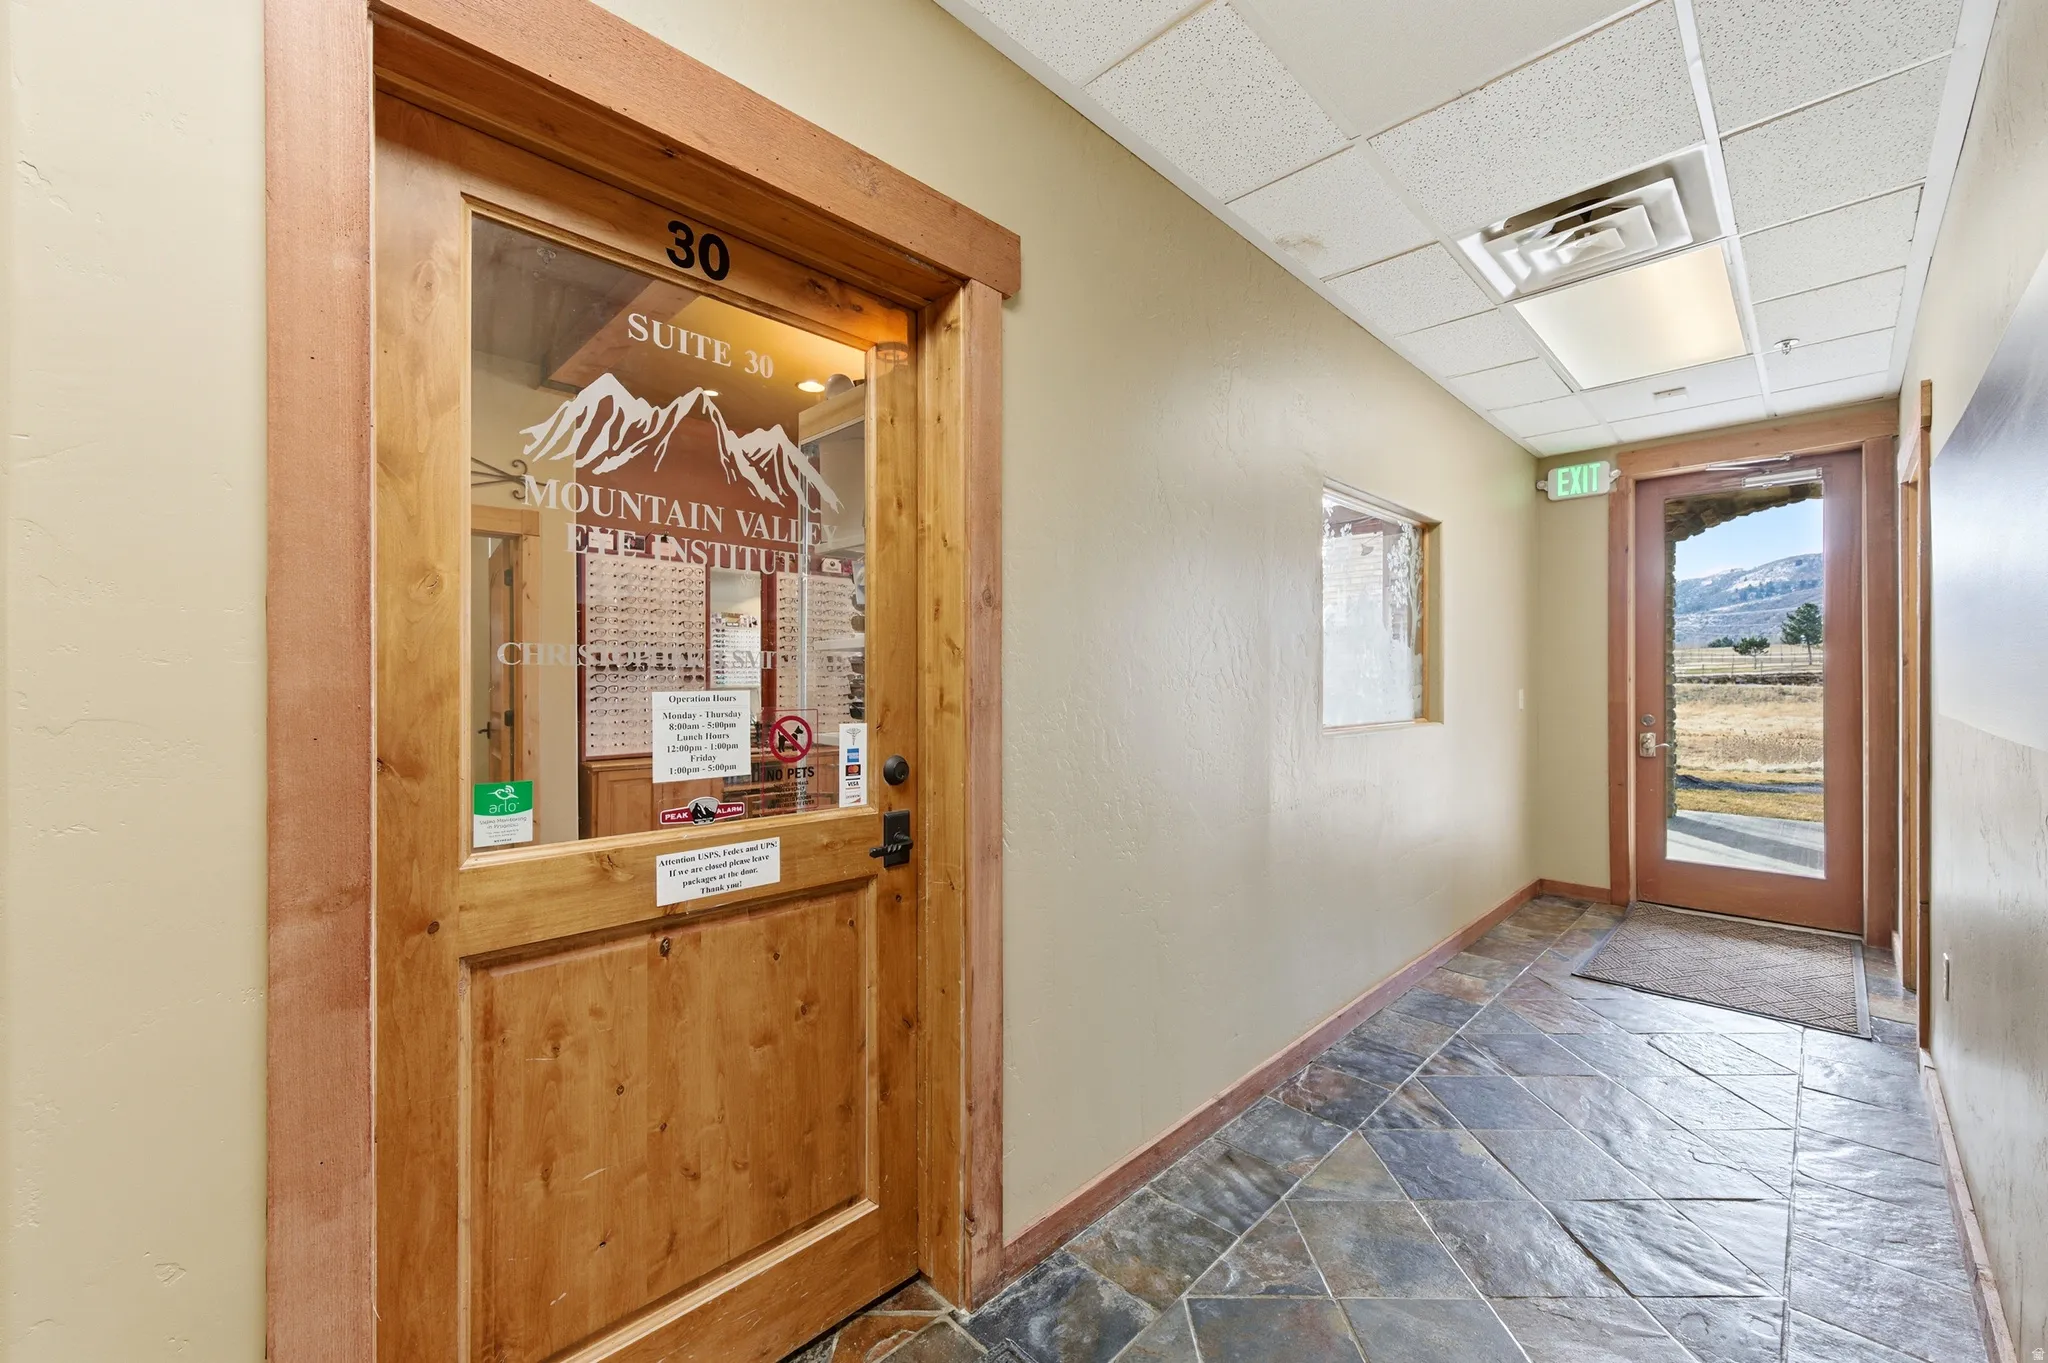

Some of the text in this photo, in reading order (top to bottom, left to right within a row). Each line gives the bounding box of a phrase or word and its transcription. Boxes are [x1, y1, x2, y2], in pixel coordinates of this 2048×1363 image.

[665, 220, 730, 281] 30
[628, 313, 774, 379] SUITE 30
[1557, 462, 1601, 497] EXIT
[521, 474, 838, 549] MOUNTAIN VALLEY
[565, 522, 636, 559] EYE
[668, 694, 737, 704] Operation Hours
[662, 711, 697, 720] Monday
[705, 710, 742, 719] Thursday
[668, 722, 699, 731] 8:00am
[707, 721, 736, 730] 5:00pm
[676, 732, 730, 741] Lunch Hours
[667, 744, 702, 753] 12:00pm
[710, 742, 739, 751] 1:00pm
[690, 754, 717, 763] Friday
[669, 766, 700, 775] 1:00pm
[707, 764, 737, 772] 5:00pm
[767, 766, 815, 781] NO PETS
[488, 800, 517, 814] arlo
[664, 812, 689, 820] PEAK
[716, 806, 743, 814] ALARM
[658, 855, 696, 867] Attention
[722, 848, 744, 857] Fedex
[745, 844, 759, 853] and
[760, 841, 778, 850] UPS!
[668, 868, 677, 878] If
[690, 866, 703, 874] are
[704, 860, 728, 871] closed
[729, 858, 751, 869] please
[751, 854, 770, 863] leave
[682, 867, 759, 888] packages at the door.
[700, 880, 742, 895] Thank you!
